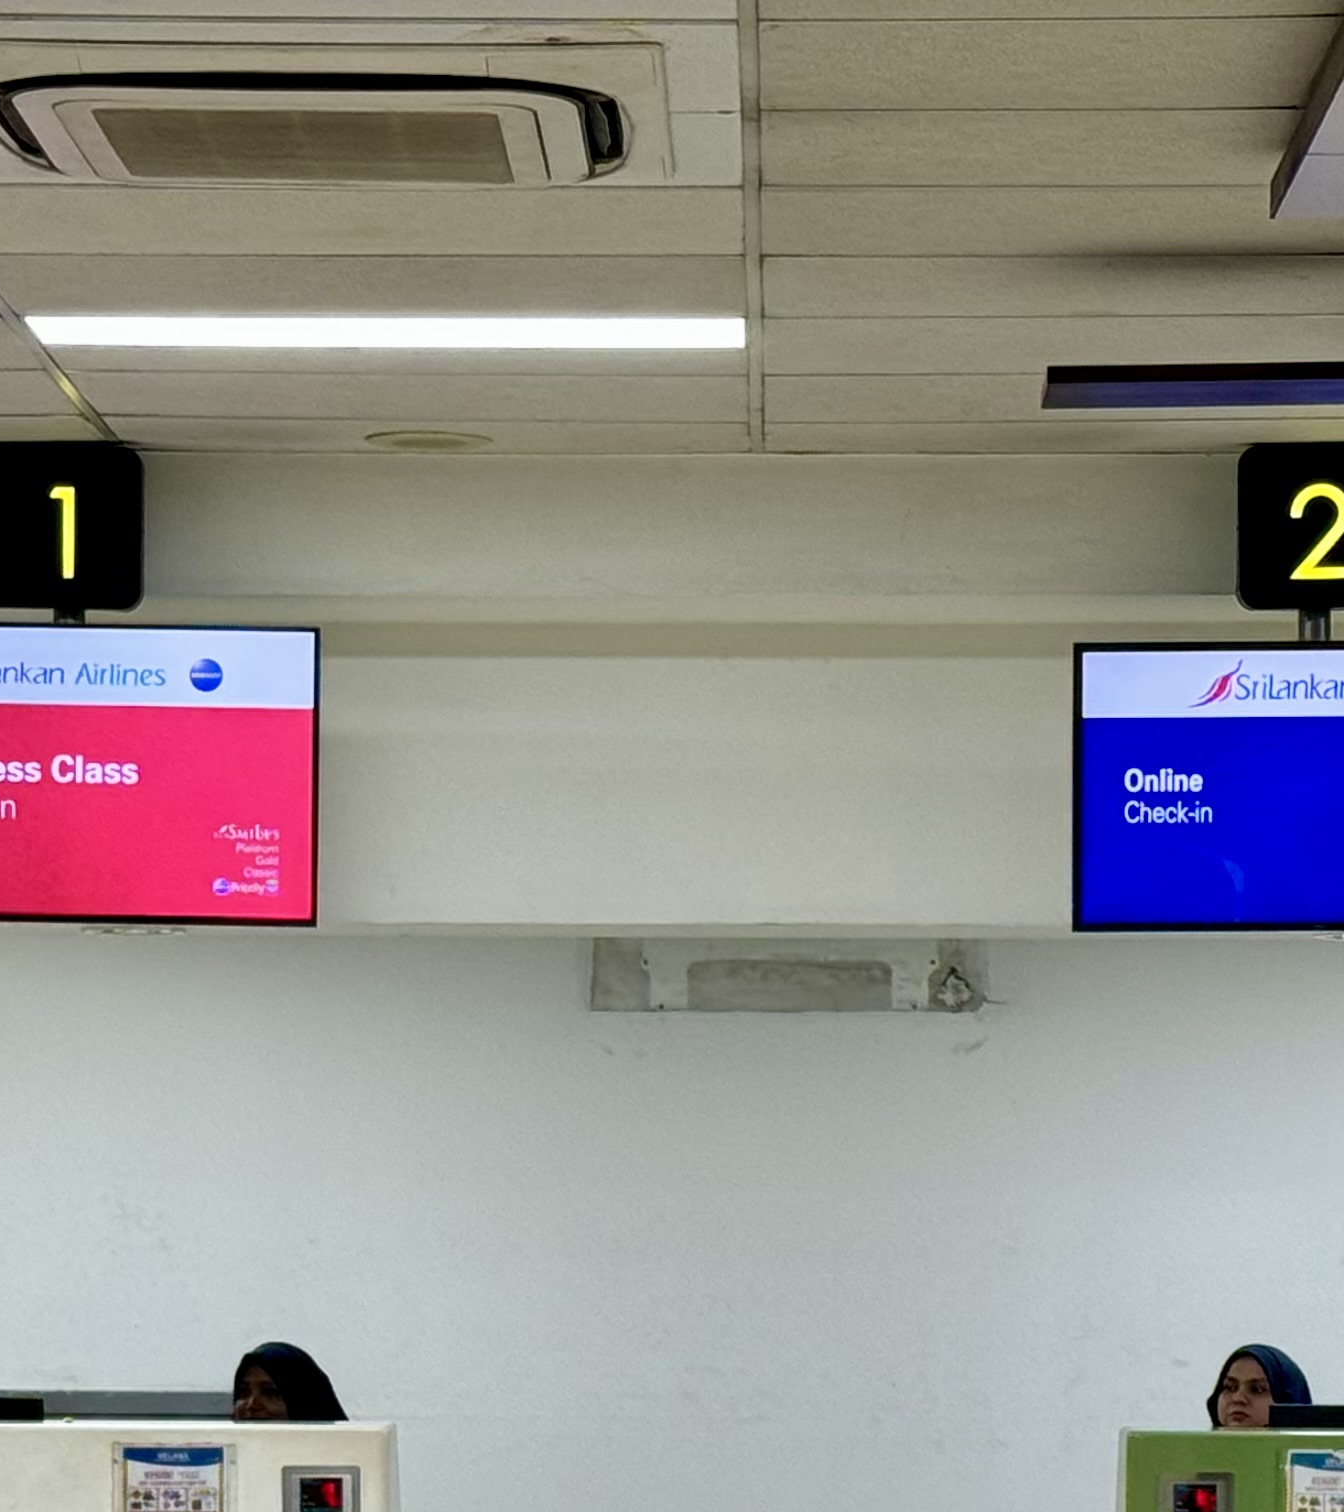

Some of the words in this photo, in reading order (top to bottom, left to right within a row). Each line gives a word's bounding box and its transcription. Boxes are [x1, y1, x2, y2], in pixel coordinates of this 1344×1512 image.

[49, 486, 76, 579] 1
[74, 662, 167, 687] Airlines
[50, 754, 140, 786] Class
[1123, 768, 1204, 794] Online
[1123, 800, 1214, 826] Check-in
